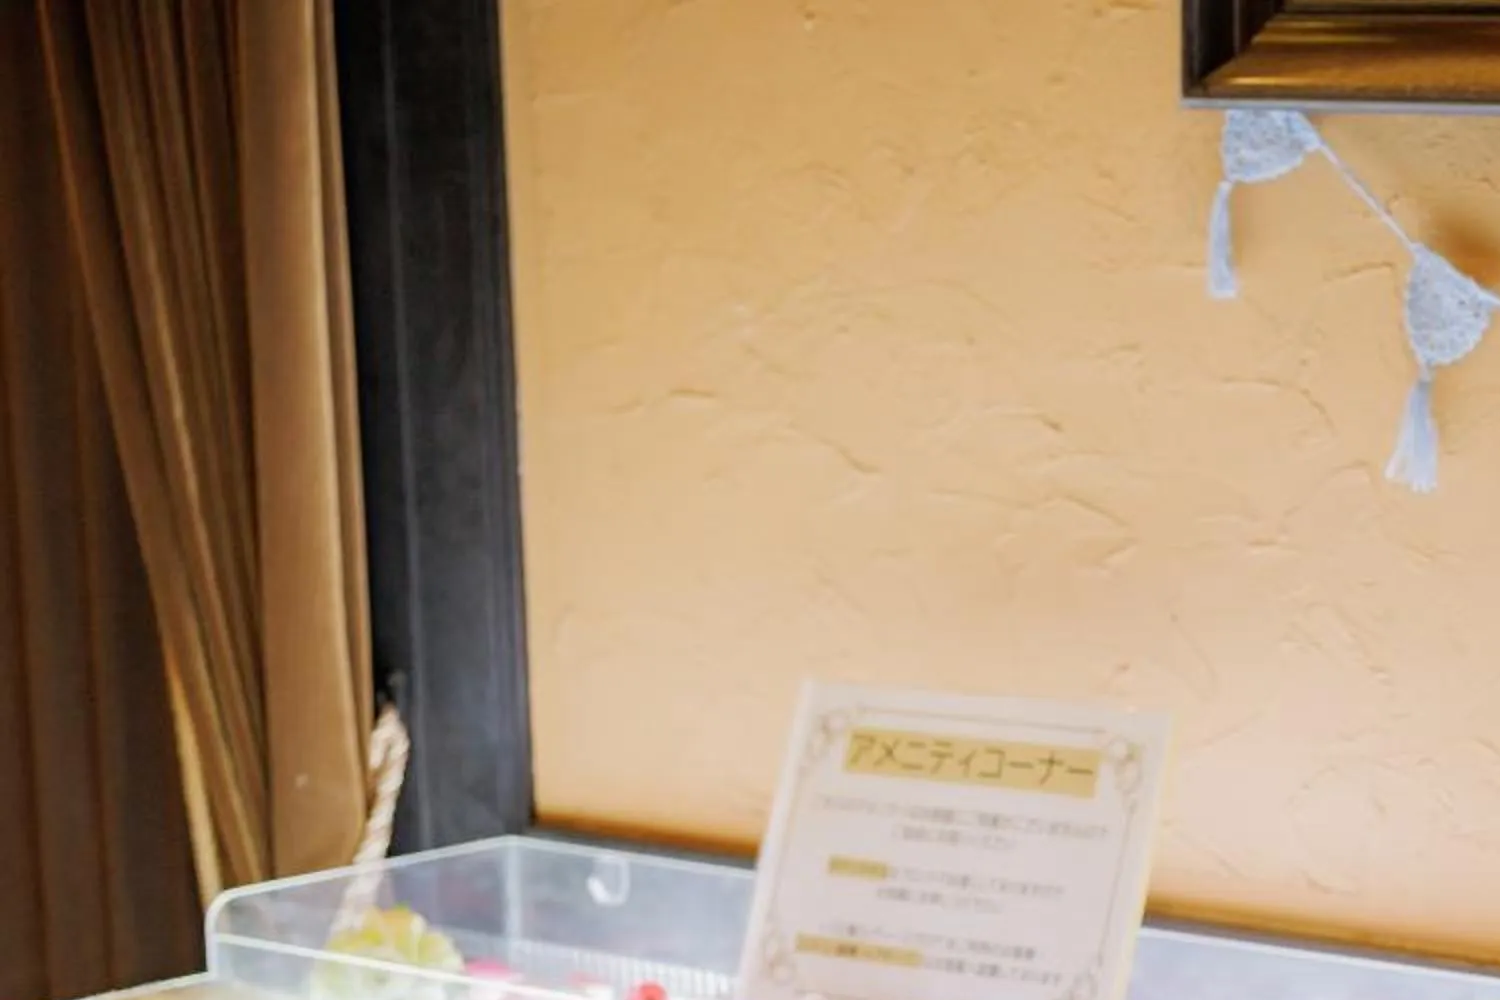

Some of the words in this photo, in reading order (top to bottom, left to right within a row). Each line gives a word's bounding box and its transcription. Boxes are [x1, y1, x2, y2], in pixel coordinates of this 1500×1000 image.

[849, 732, 1095, 787] アメニティコーナー
